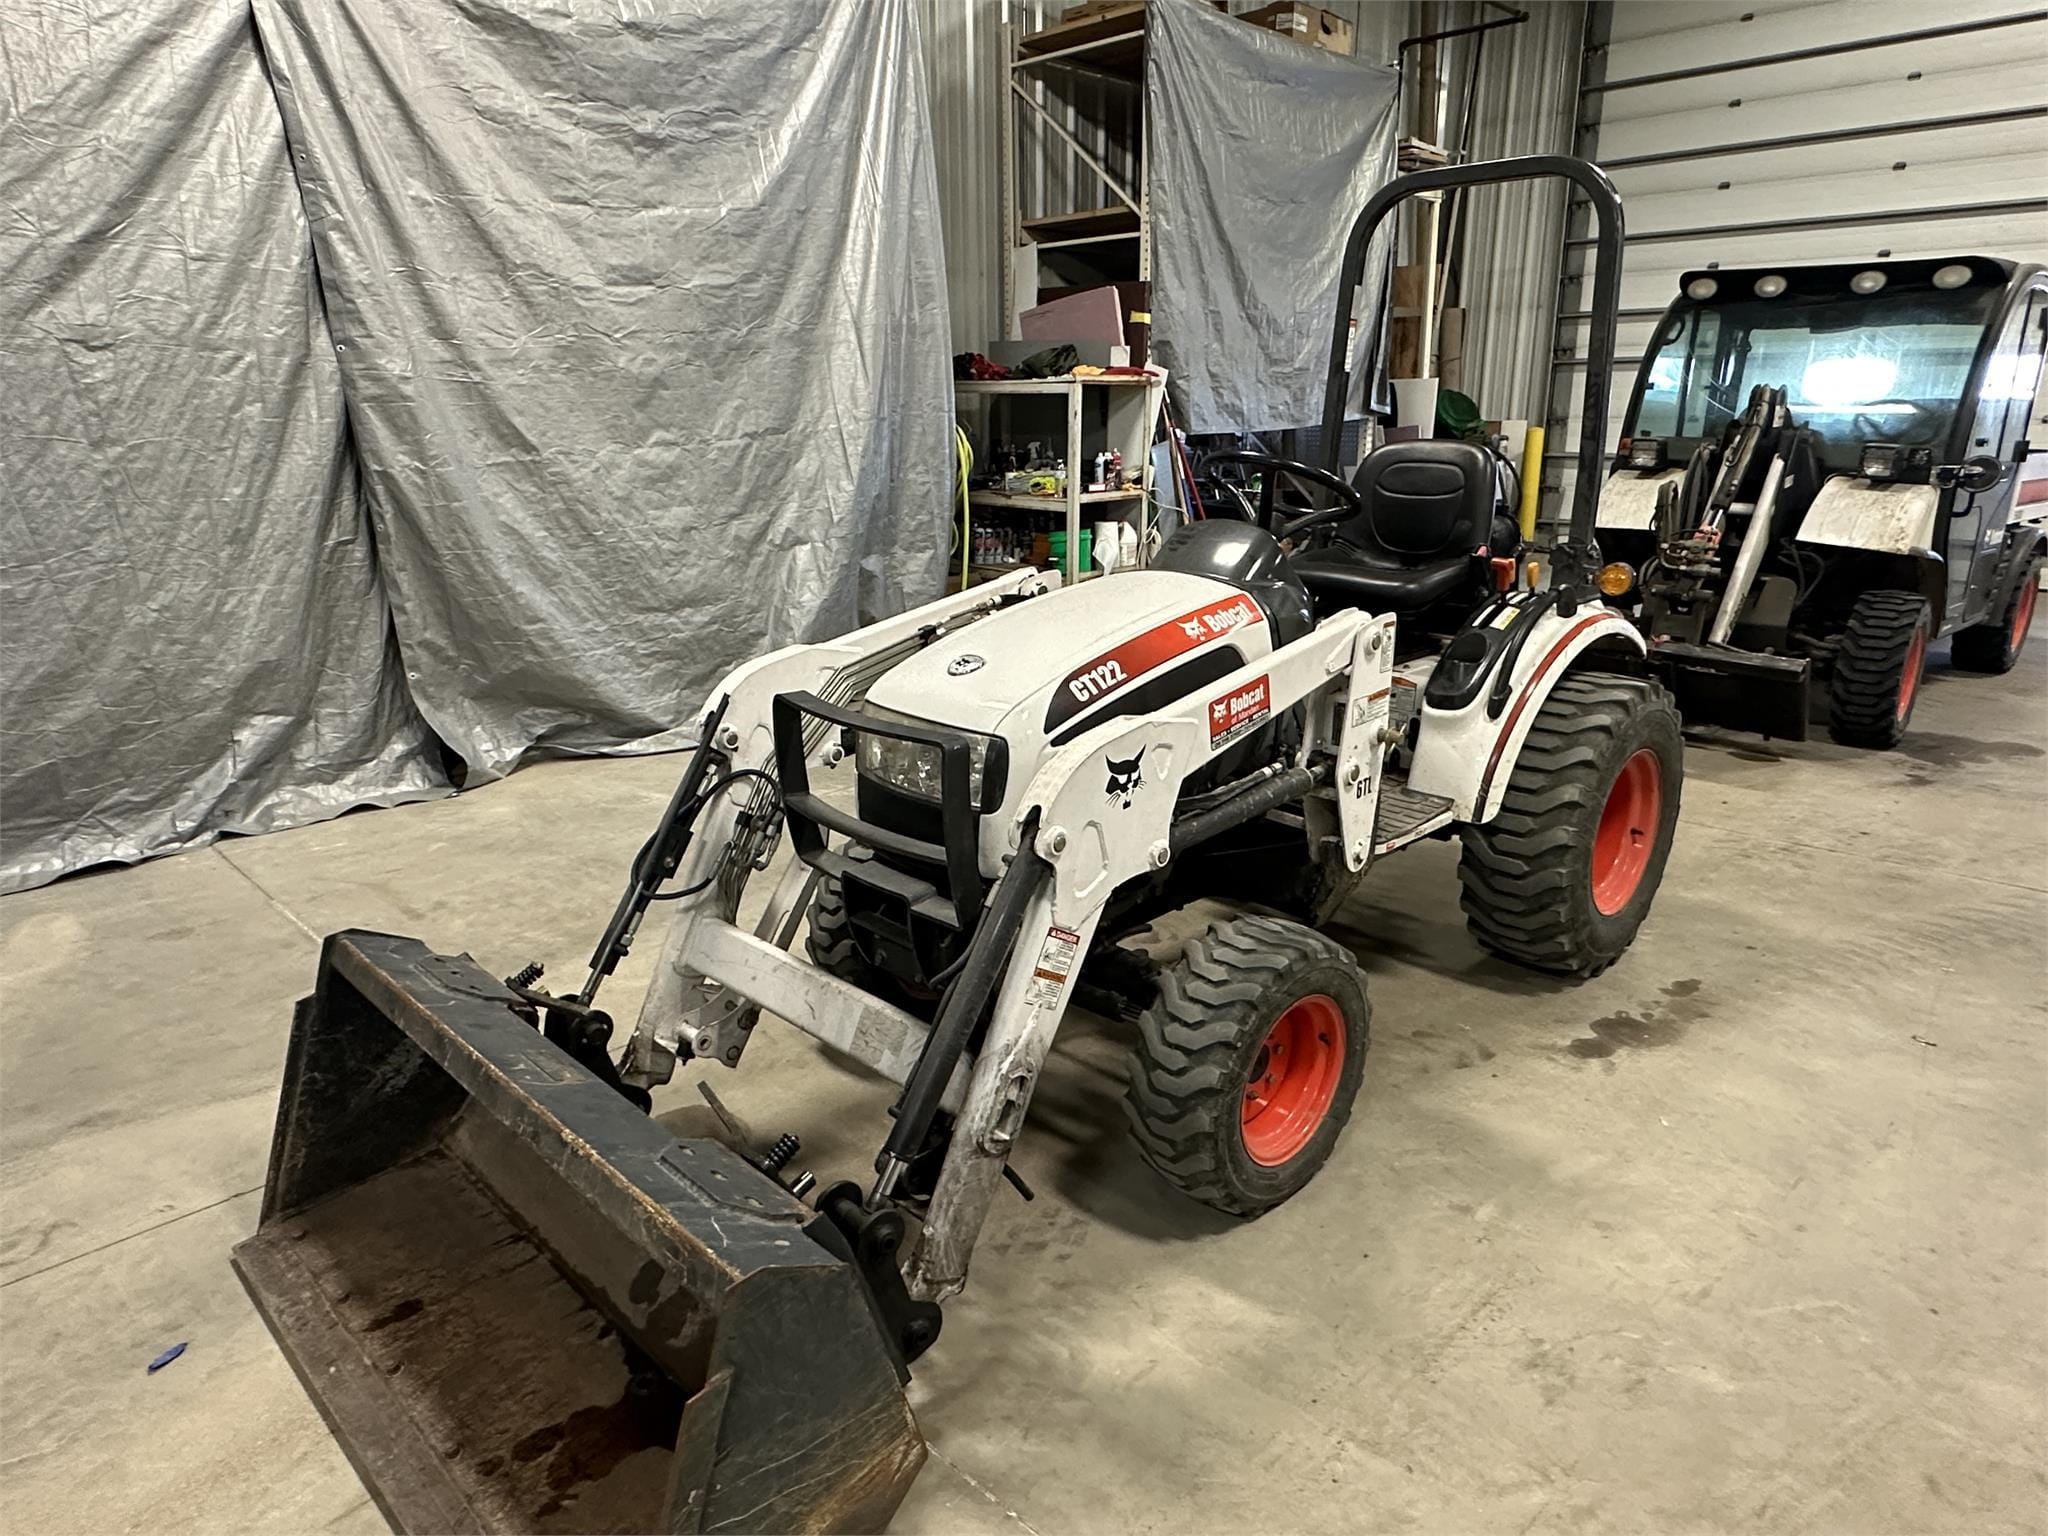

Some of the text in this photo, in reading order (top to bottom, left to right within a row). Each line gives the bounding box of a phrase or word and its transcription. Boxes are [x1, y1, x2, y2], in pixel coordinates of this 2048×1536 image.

[1202, 601, 1253, 632] Bobcat
[1069, 660, 1128, 702] CT122
[1230, 683, 1264, 715] Bobcat
[1357, 776, 1371, 799] 6TL
